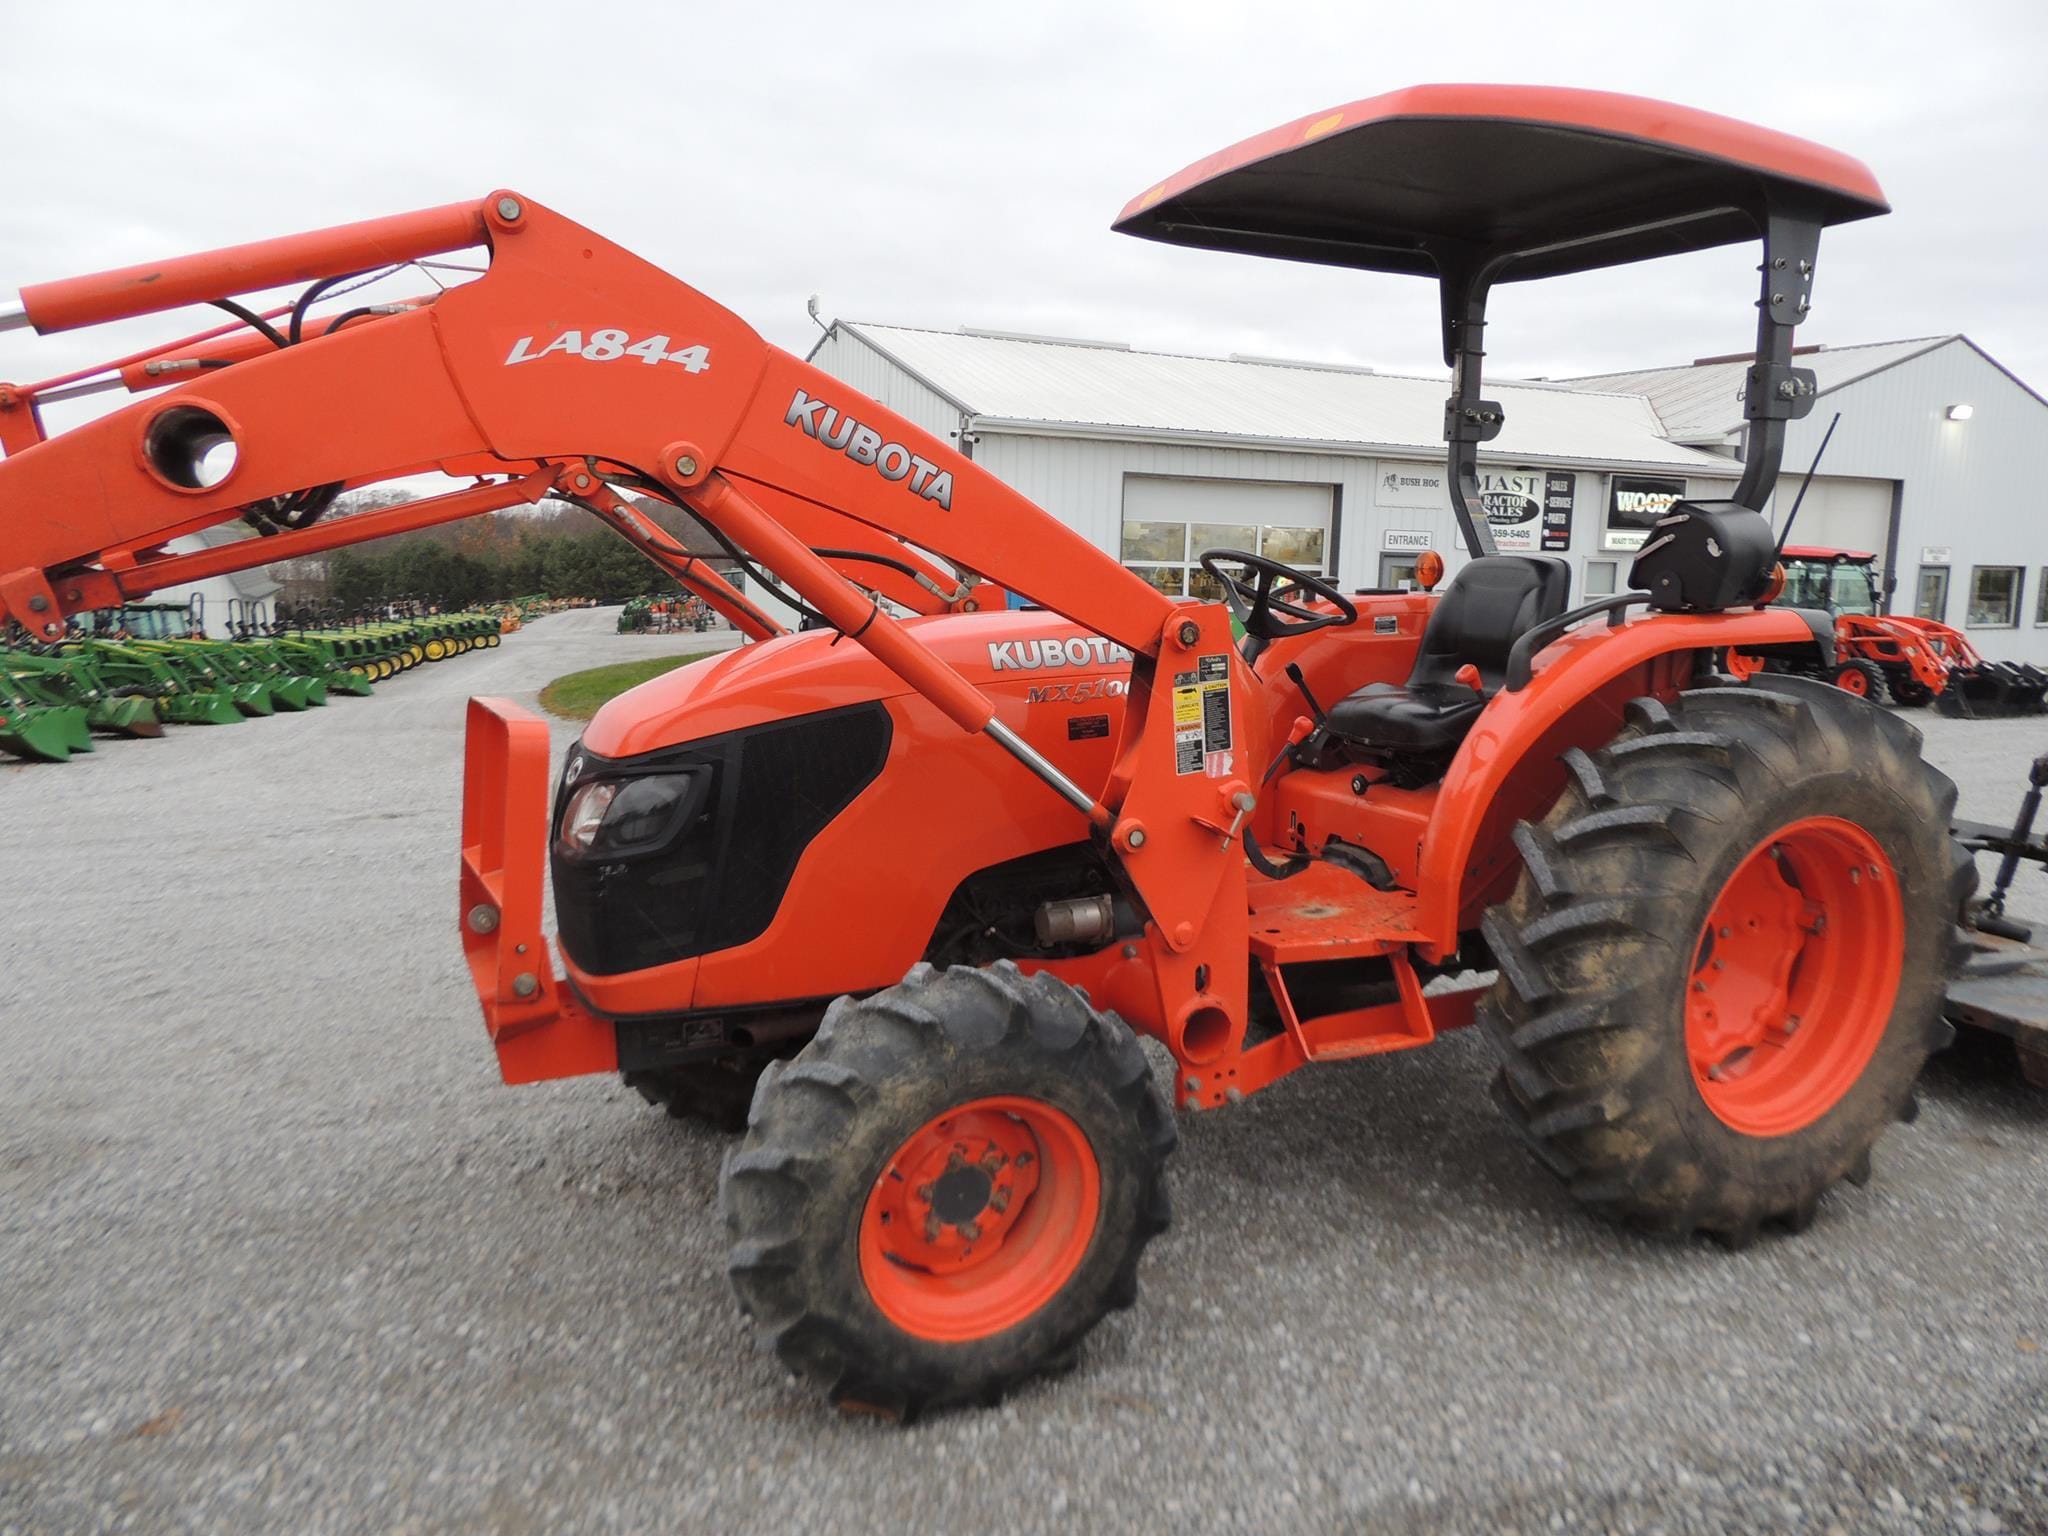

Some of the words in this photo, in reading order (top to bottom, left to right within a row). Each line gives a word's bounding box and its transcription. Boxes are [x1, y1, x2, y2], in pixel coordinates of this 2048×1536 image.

[503, 328, 711, 374] LA844
[783, 388, 955, 513] KUBOTA
[1400, 476, 1421, 487] BUSH
[1422, 478, 1440, 488] HOG
[1482, 494, 1528, 508] RACTOR
[1388, 534, 1429, 546] ENTRANCE
[987, 636, 1137, 671] KUBOTA
